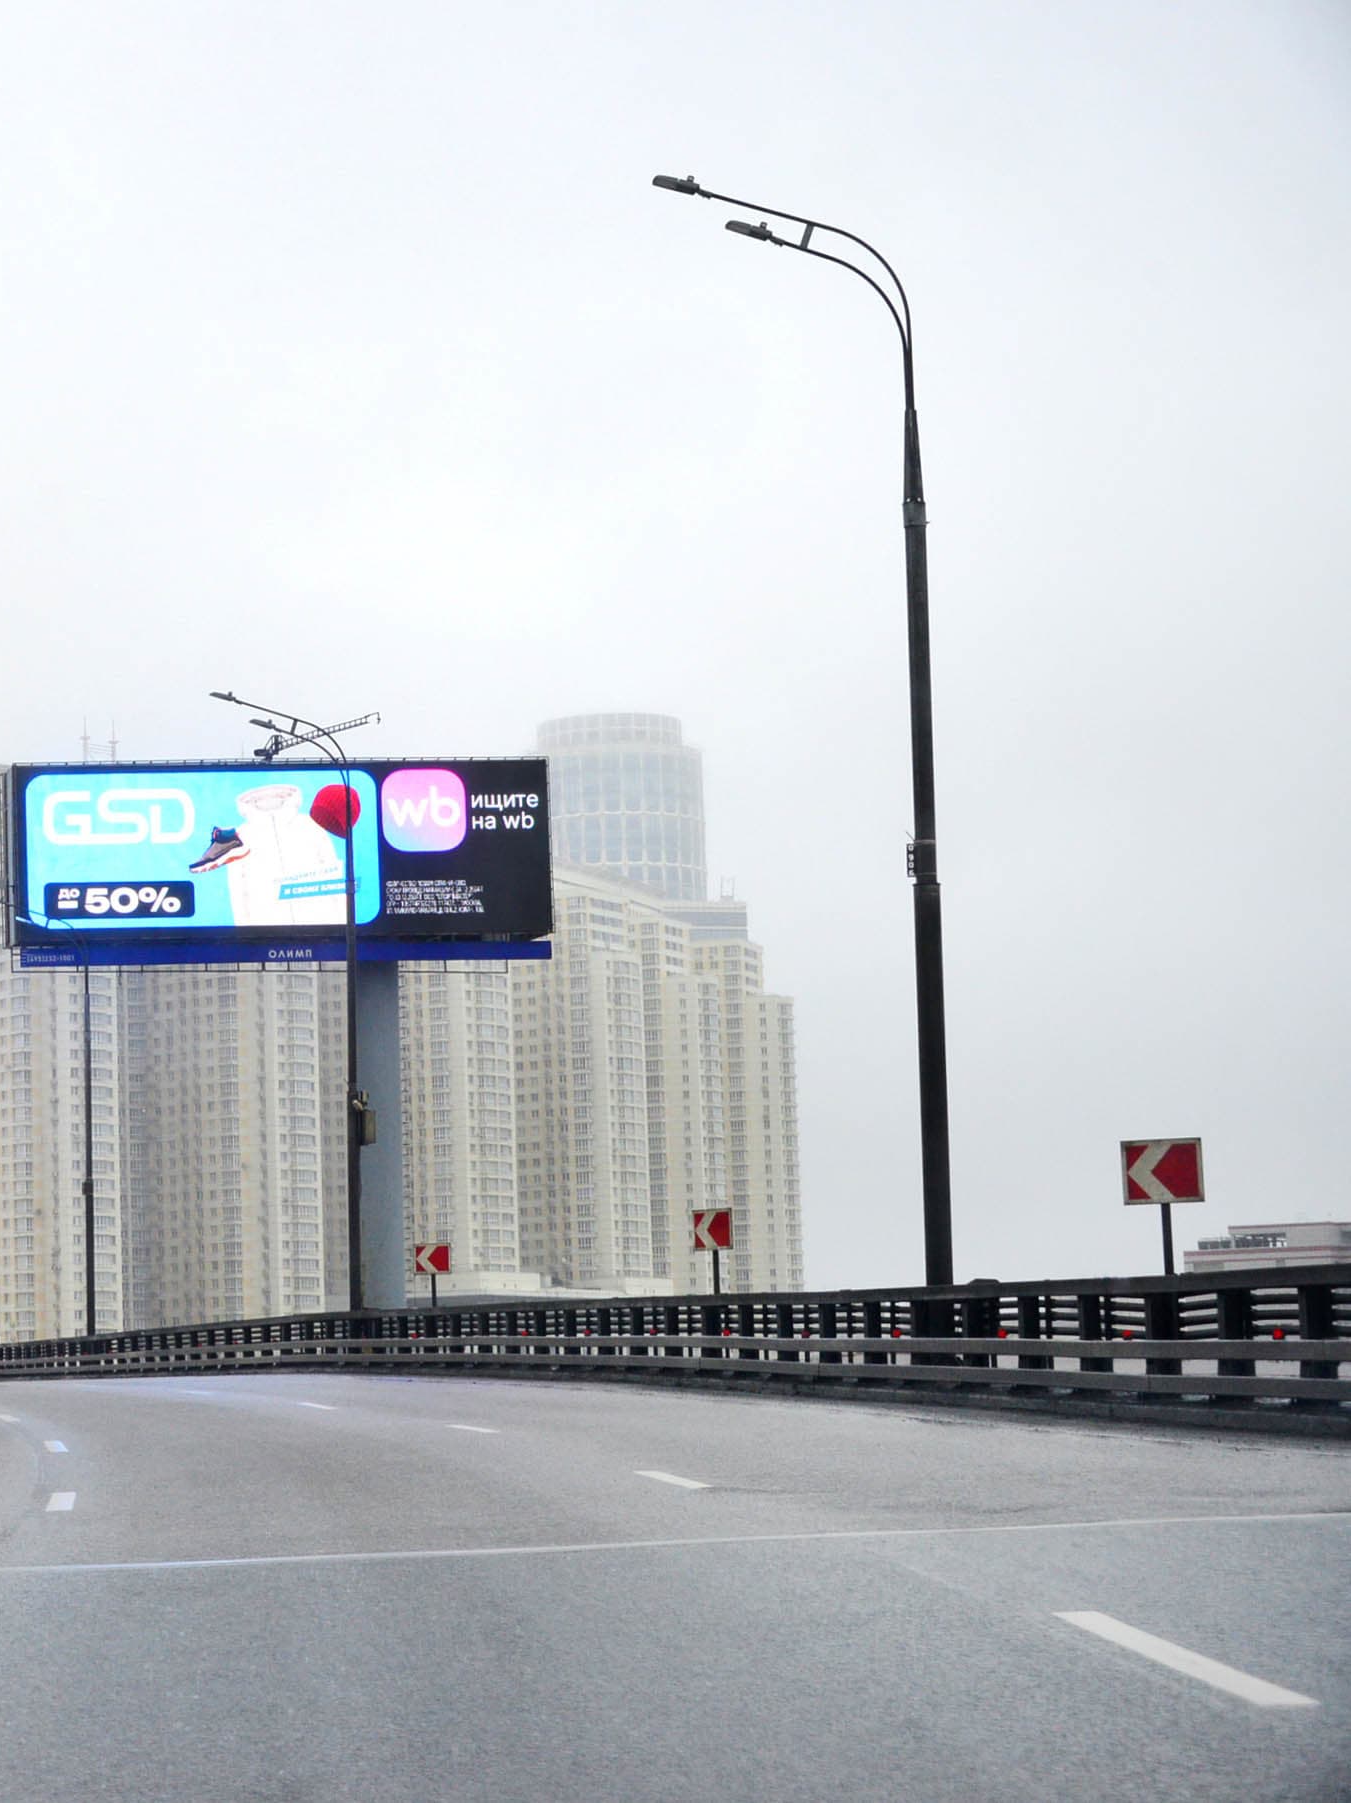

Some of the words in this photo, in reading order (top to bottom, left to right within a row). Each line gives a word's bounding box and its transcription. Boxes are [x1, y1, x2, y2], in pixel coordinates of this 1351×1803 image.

[387, 785, 461, 828] wb
[471, 793, 539, 811] ищите
[42, 788, 195, 845] GSD
[471, 815, 497, 830] на
[503, 810, 535, 830] wb
[268, 949, 312, 959] ОЛИМП
